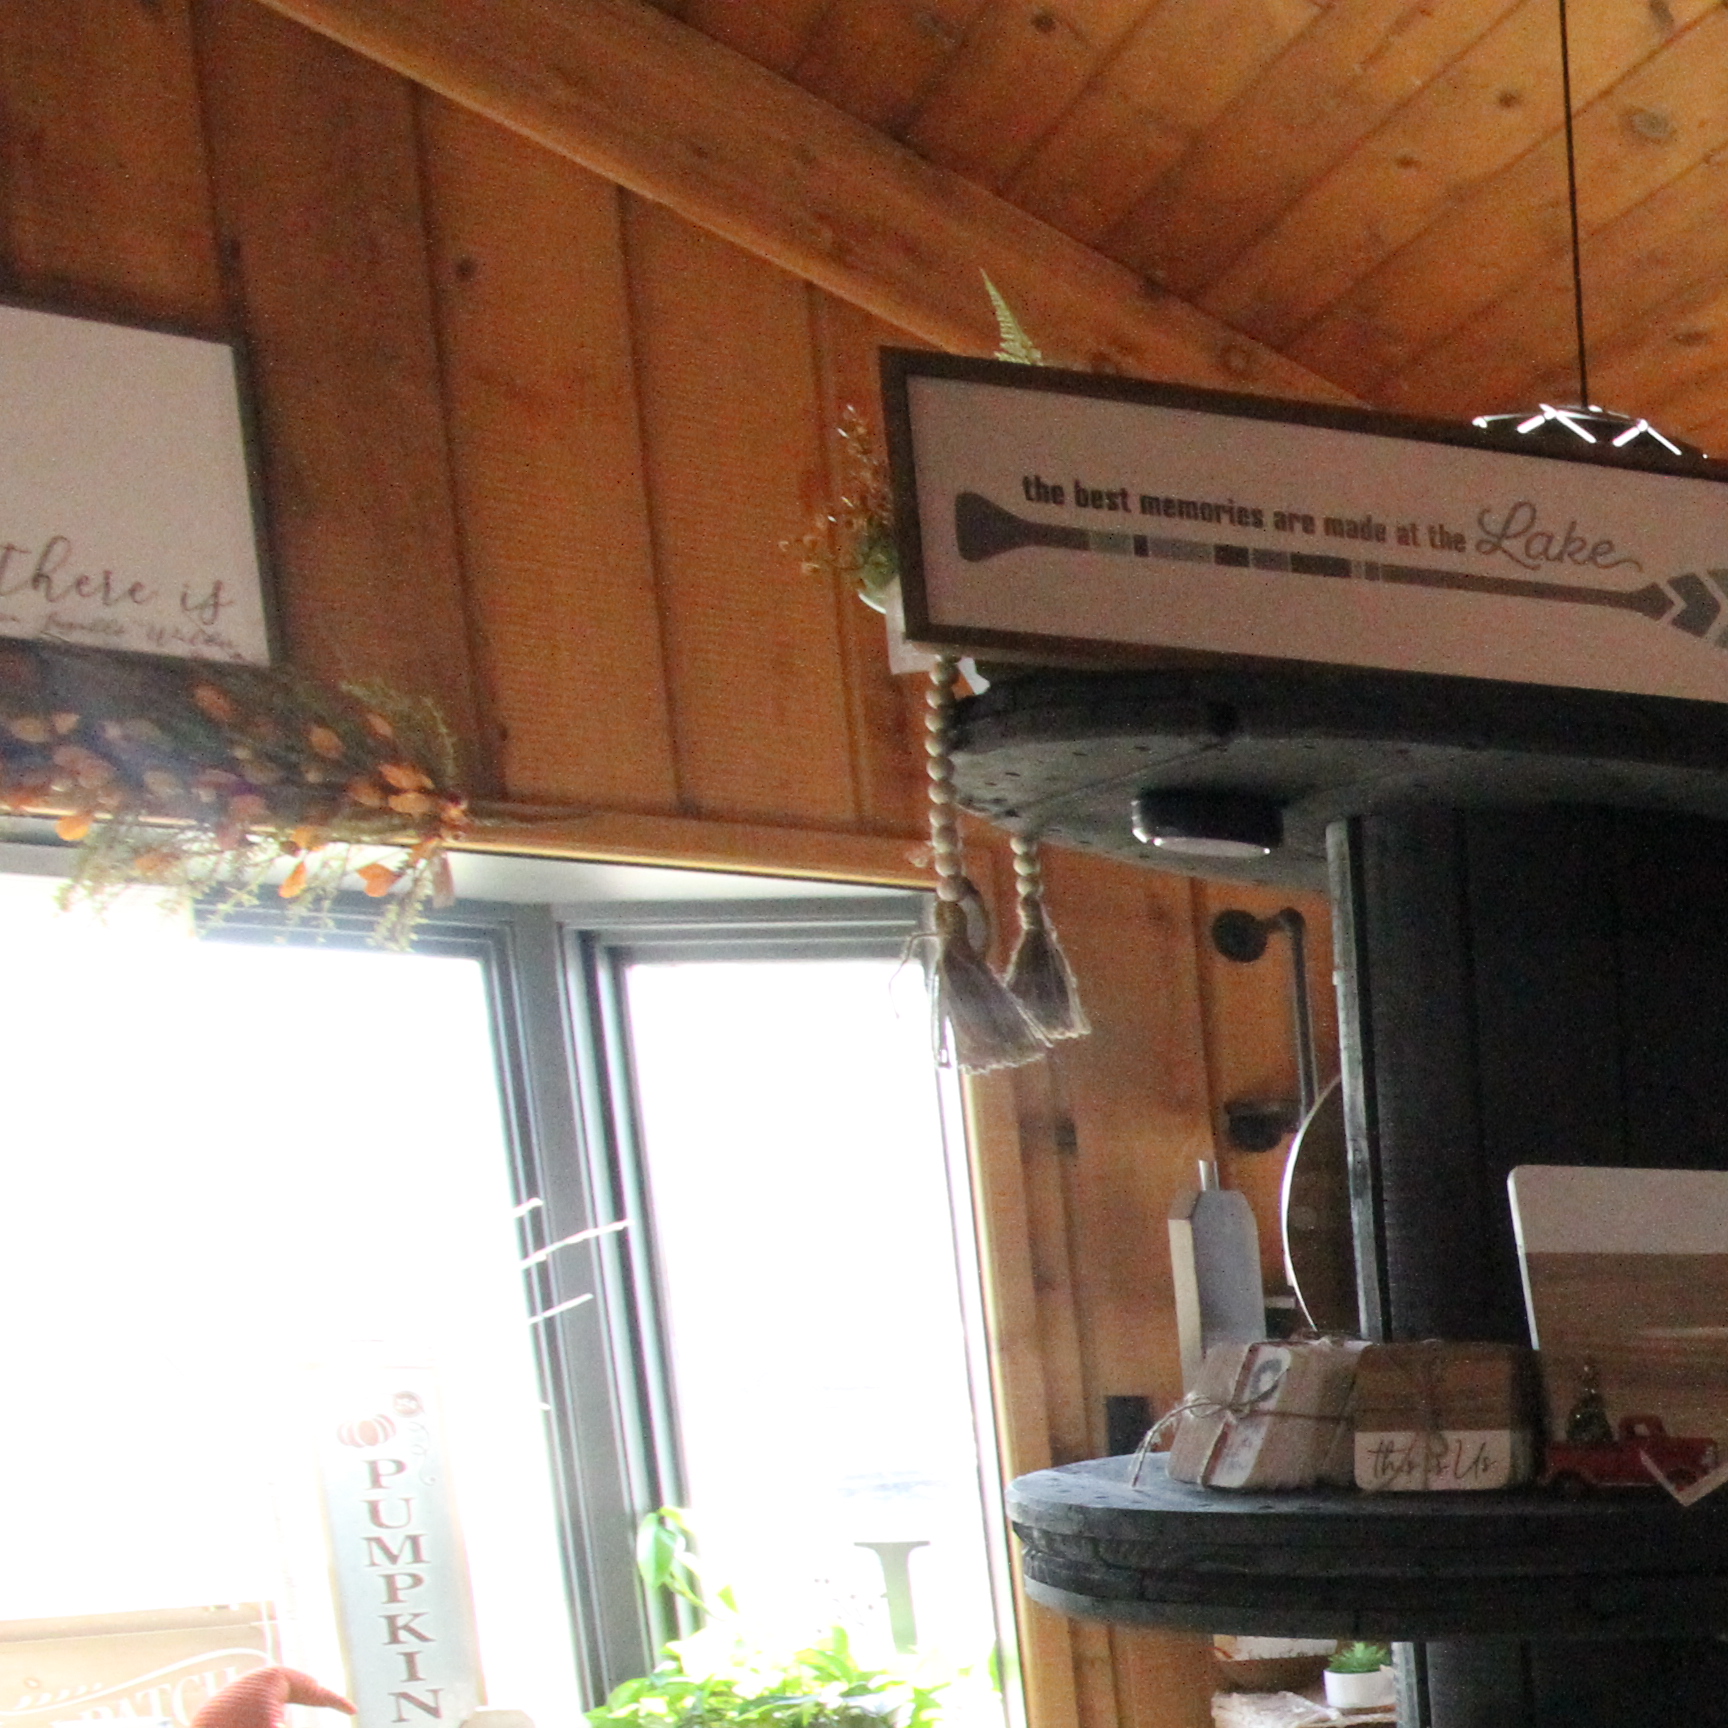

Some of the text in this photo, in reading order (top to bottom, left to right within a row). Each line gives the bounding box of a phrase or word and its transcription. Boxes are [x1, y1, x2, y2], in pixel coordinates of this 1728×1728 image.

[1022, 476, 1642, 573] the best memories are made at the Lake
[360, 1458, 444, 1724] PUMPKIN
